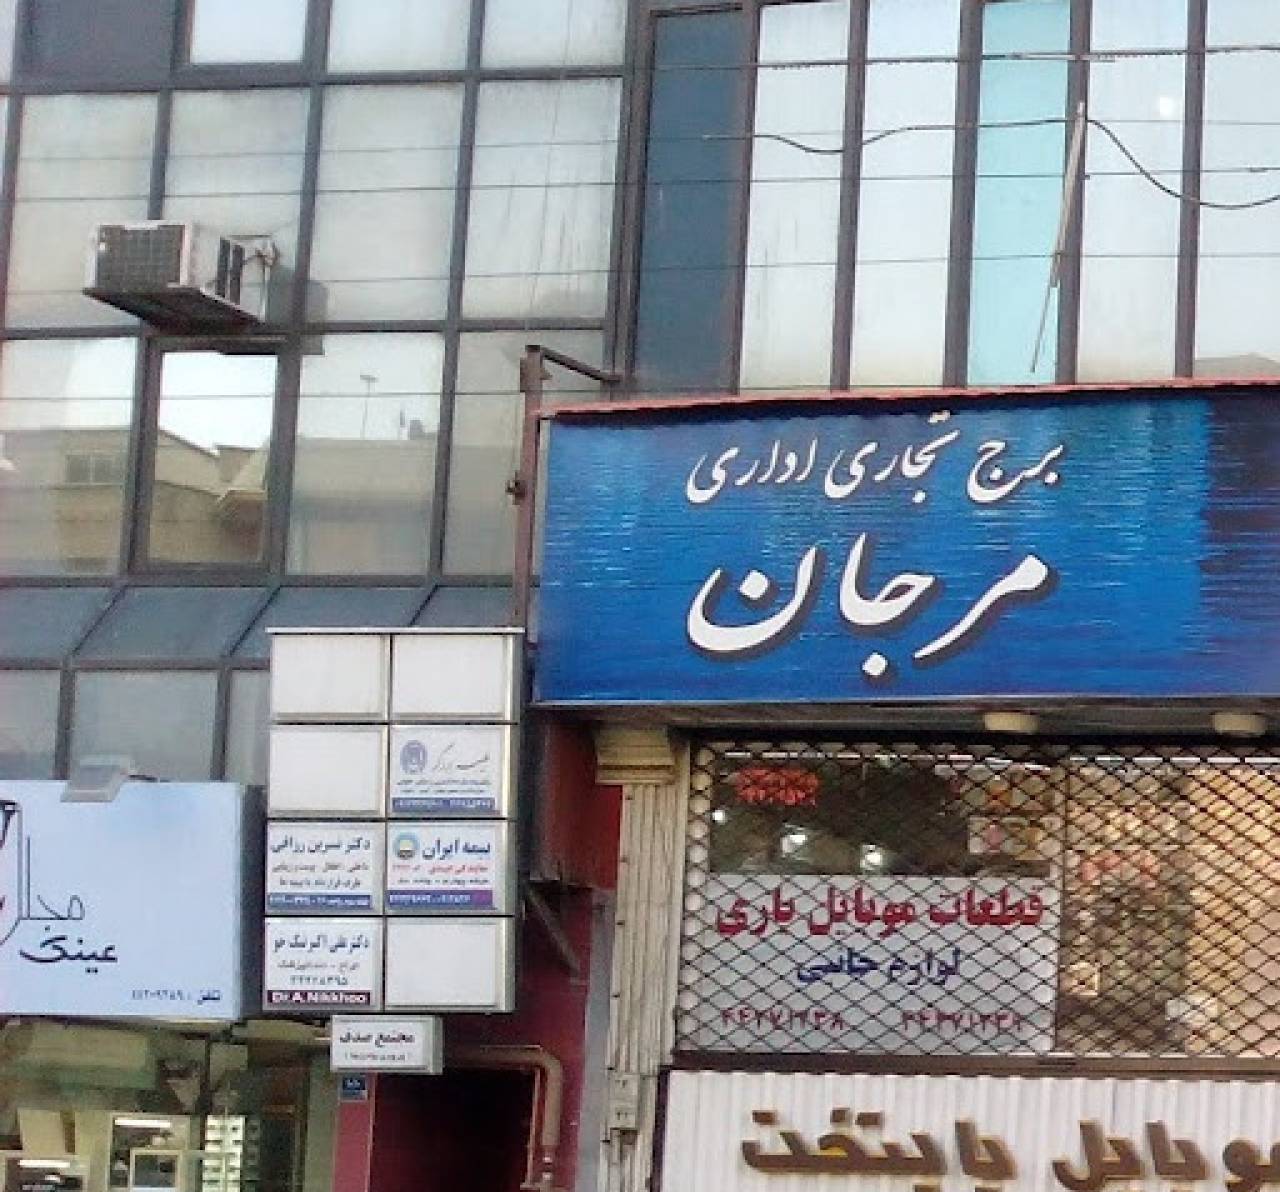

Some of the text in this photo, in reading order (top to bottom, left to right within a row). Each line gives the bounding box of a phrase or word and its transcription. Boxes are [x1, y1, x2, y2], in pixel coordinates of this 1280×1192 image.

[687, 413, 1064, 503] برج تجاری اداری
[687, 532, 1049, 676] مرجان
[346, 836, 370, 854] دکتر
[422, 837, 491, 860] بیمه ایران
[809, 886, 916, 940] موبایل
[930, 885, 1043, 926] قطعات
[349, 935, 369, 953] دکتر
[888, 947, 961, 987] لوازم
